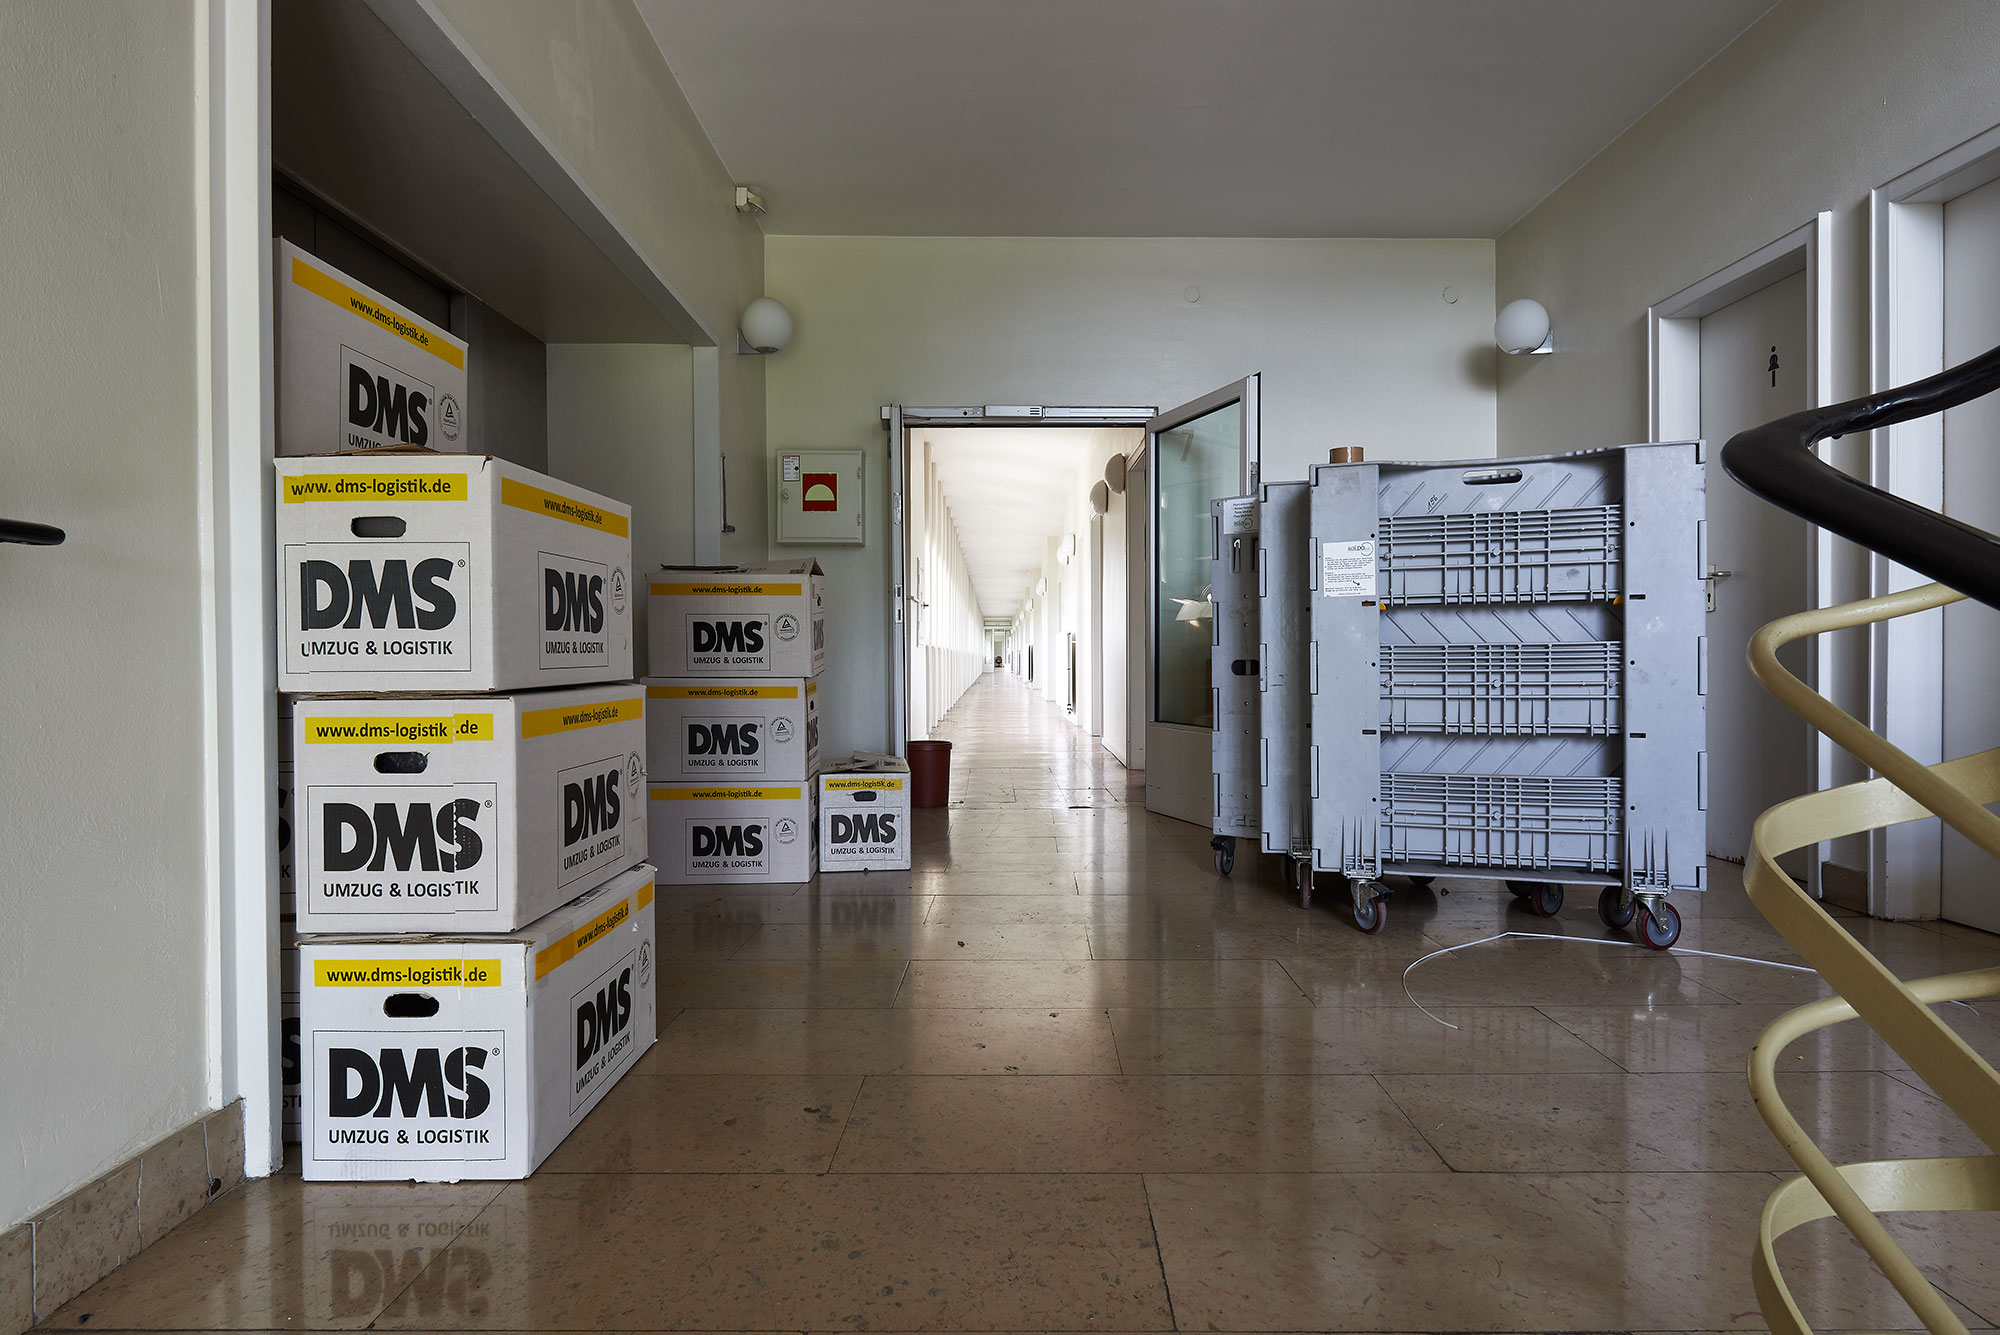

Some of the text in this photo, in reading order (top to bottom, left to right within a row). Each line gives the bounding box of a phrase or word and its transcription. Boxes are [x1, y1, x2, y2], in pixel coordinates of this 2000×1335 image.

[350, 297, 429, 346] www.dms-logistik.de
[543, 498, 602, 524] www.dms-logistik.de
[692, 582, 763, 595] www.dms-logistik.de
[301, 640, 453, 657] UMZUG & LOGISTIK
[545, 641, 604, 654] UMZUG & LOGISTIK
[693, 656, 764, 664] UMZUG & LOGISTIK
[687, 688, 759, 697] www.dms-logistik.de
[562, 706, 619, 726] www.dms-logistik.de
[688, 759, 759, 767] UMZUG & LOGISTIK
[828, 780, 895, 788] www.dms-logistik.de
[692, 790, 763, 799] www.dms-logistik.de
[563, 833, 621, 870] UMZUG & LOGISTIK
[692, 860, 763, 868] UMZUG & LOGISTIK
[323, 881, 479, 897] UMZUG & LOGISTIK
[327, 966, 487, 985] www.dms-logistik.de
[575, 1031, 631, 1094] UMZUG & LOGISTIK
[328, 1129, 490, 1144] UMZUG & LOGISTIK
